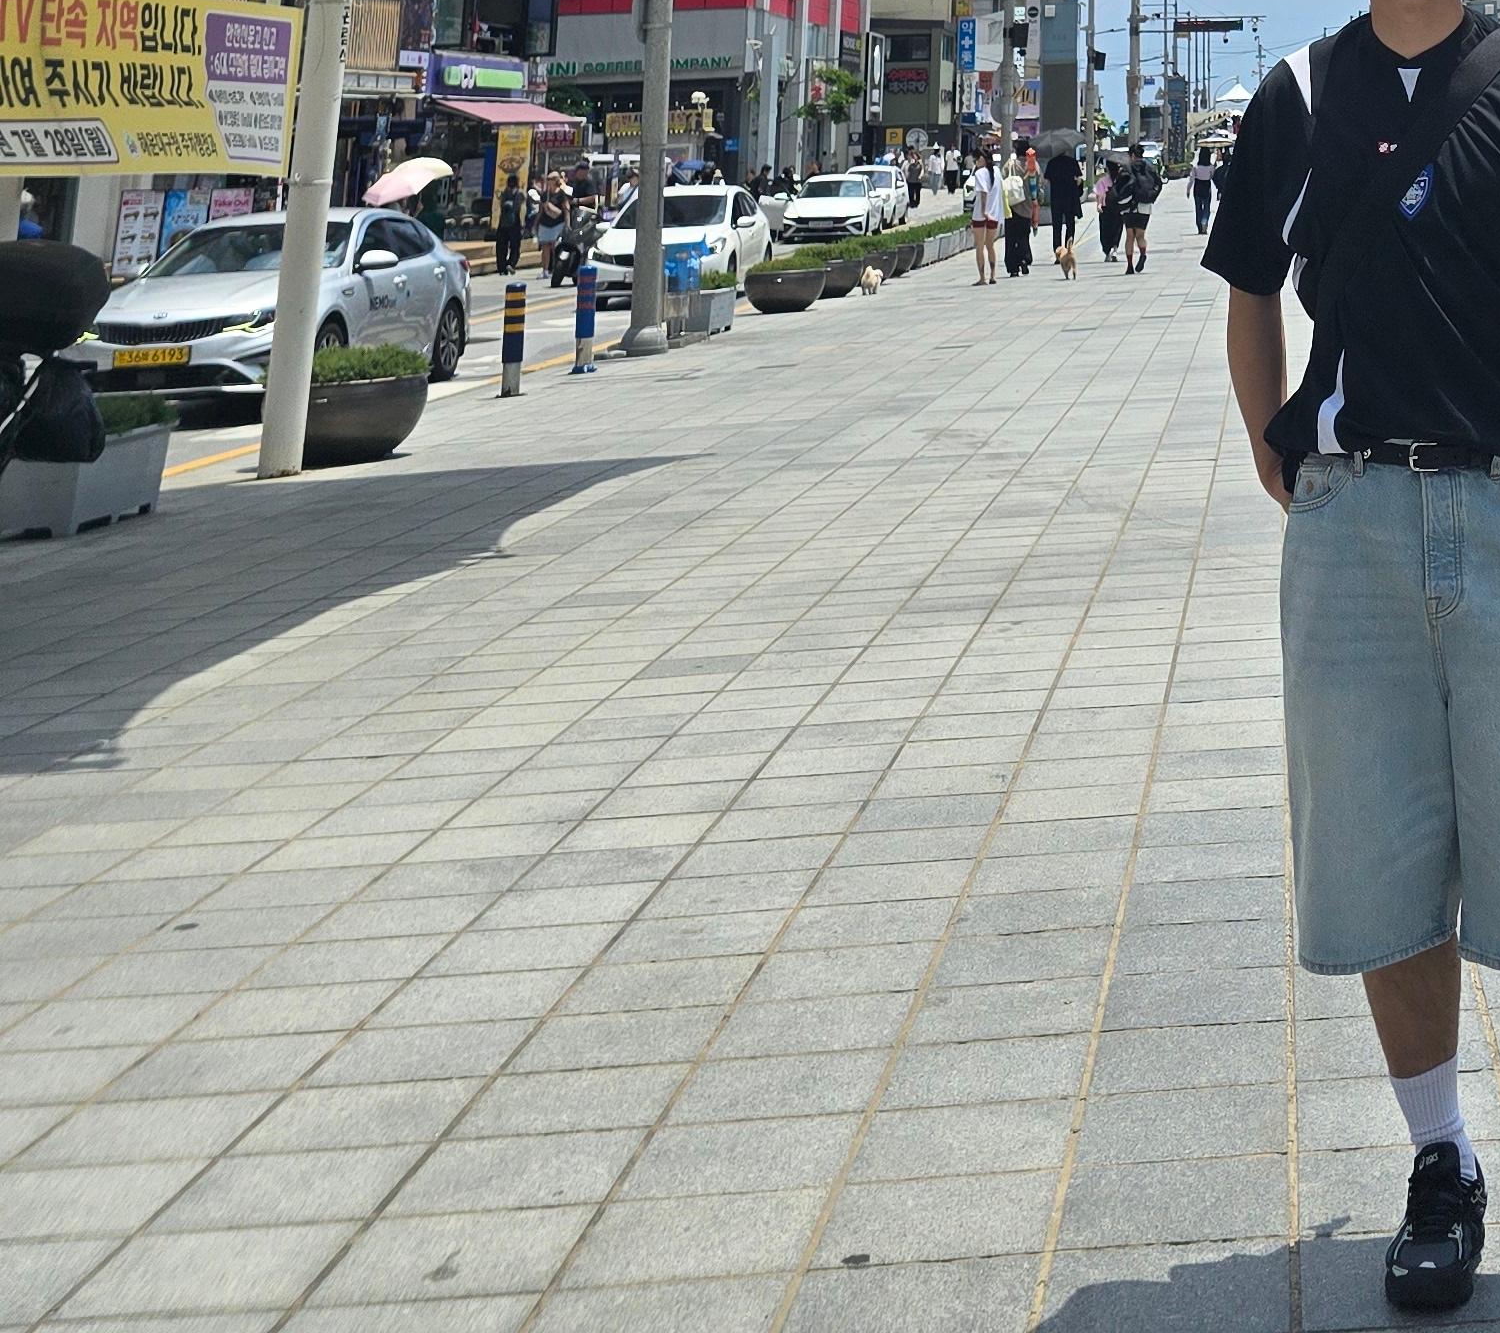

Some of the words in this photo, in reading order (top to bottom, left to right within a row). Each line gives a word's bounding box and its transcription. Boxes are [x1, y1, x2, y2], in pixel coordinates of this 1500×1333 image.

[670, 55, 732, 70] OMPANY
[44, 58, 120, 108] 주시기
[12, 128, 48, 158] 7월
[44, 125, 112, 158] 28일(월)
[889, 131, 899, 142] P
[152, 347, 184, 362] 6193
